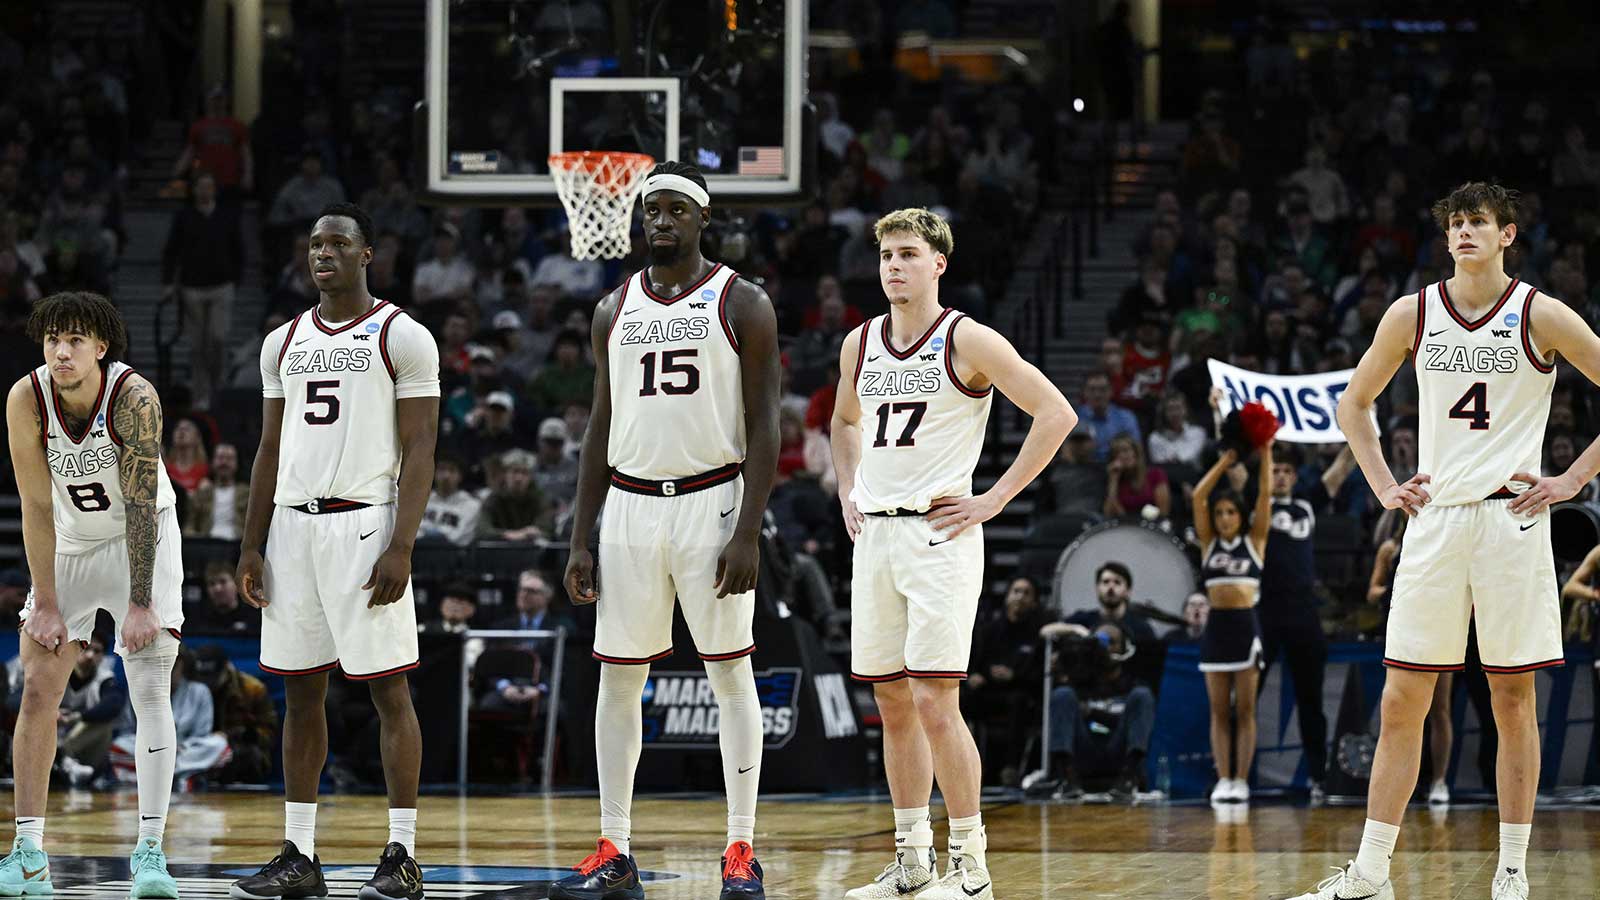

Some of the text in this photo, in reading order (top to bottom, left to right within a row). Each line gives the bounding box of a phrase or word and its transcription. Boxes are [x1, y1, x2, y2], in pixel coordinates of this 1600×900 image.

[688, 302, 708, 310] WCC
[620, 316, 710, 346] ZAGS
[1491, 329, 1512, 338] WCC
[287, 347, 372, 376] ZAGS
[920, 352, 938, 362] WCC
[1425, 343, 1519, 374] ZAGS
[639, 348, 700, 397] 15
[861, 367, 941, 397] ZAGS
[303, 379, 341, 425] 5
[1448, 381, 1490, 431] 4
[872, 401, 928, 449] 17
[47, 443, 117, 478] ZAGS
[66, 481, 112, 513] 8
[661, 481, 677, 496] G
[307, 499, 320, 514] G
[654, 677, 720, 705] MAR
[664, 706, 793, 735] MADSS
